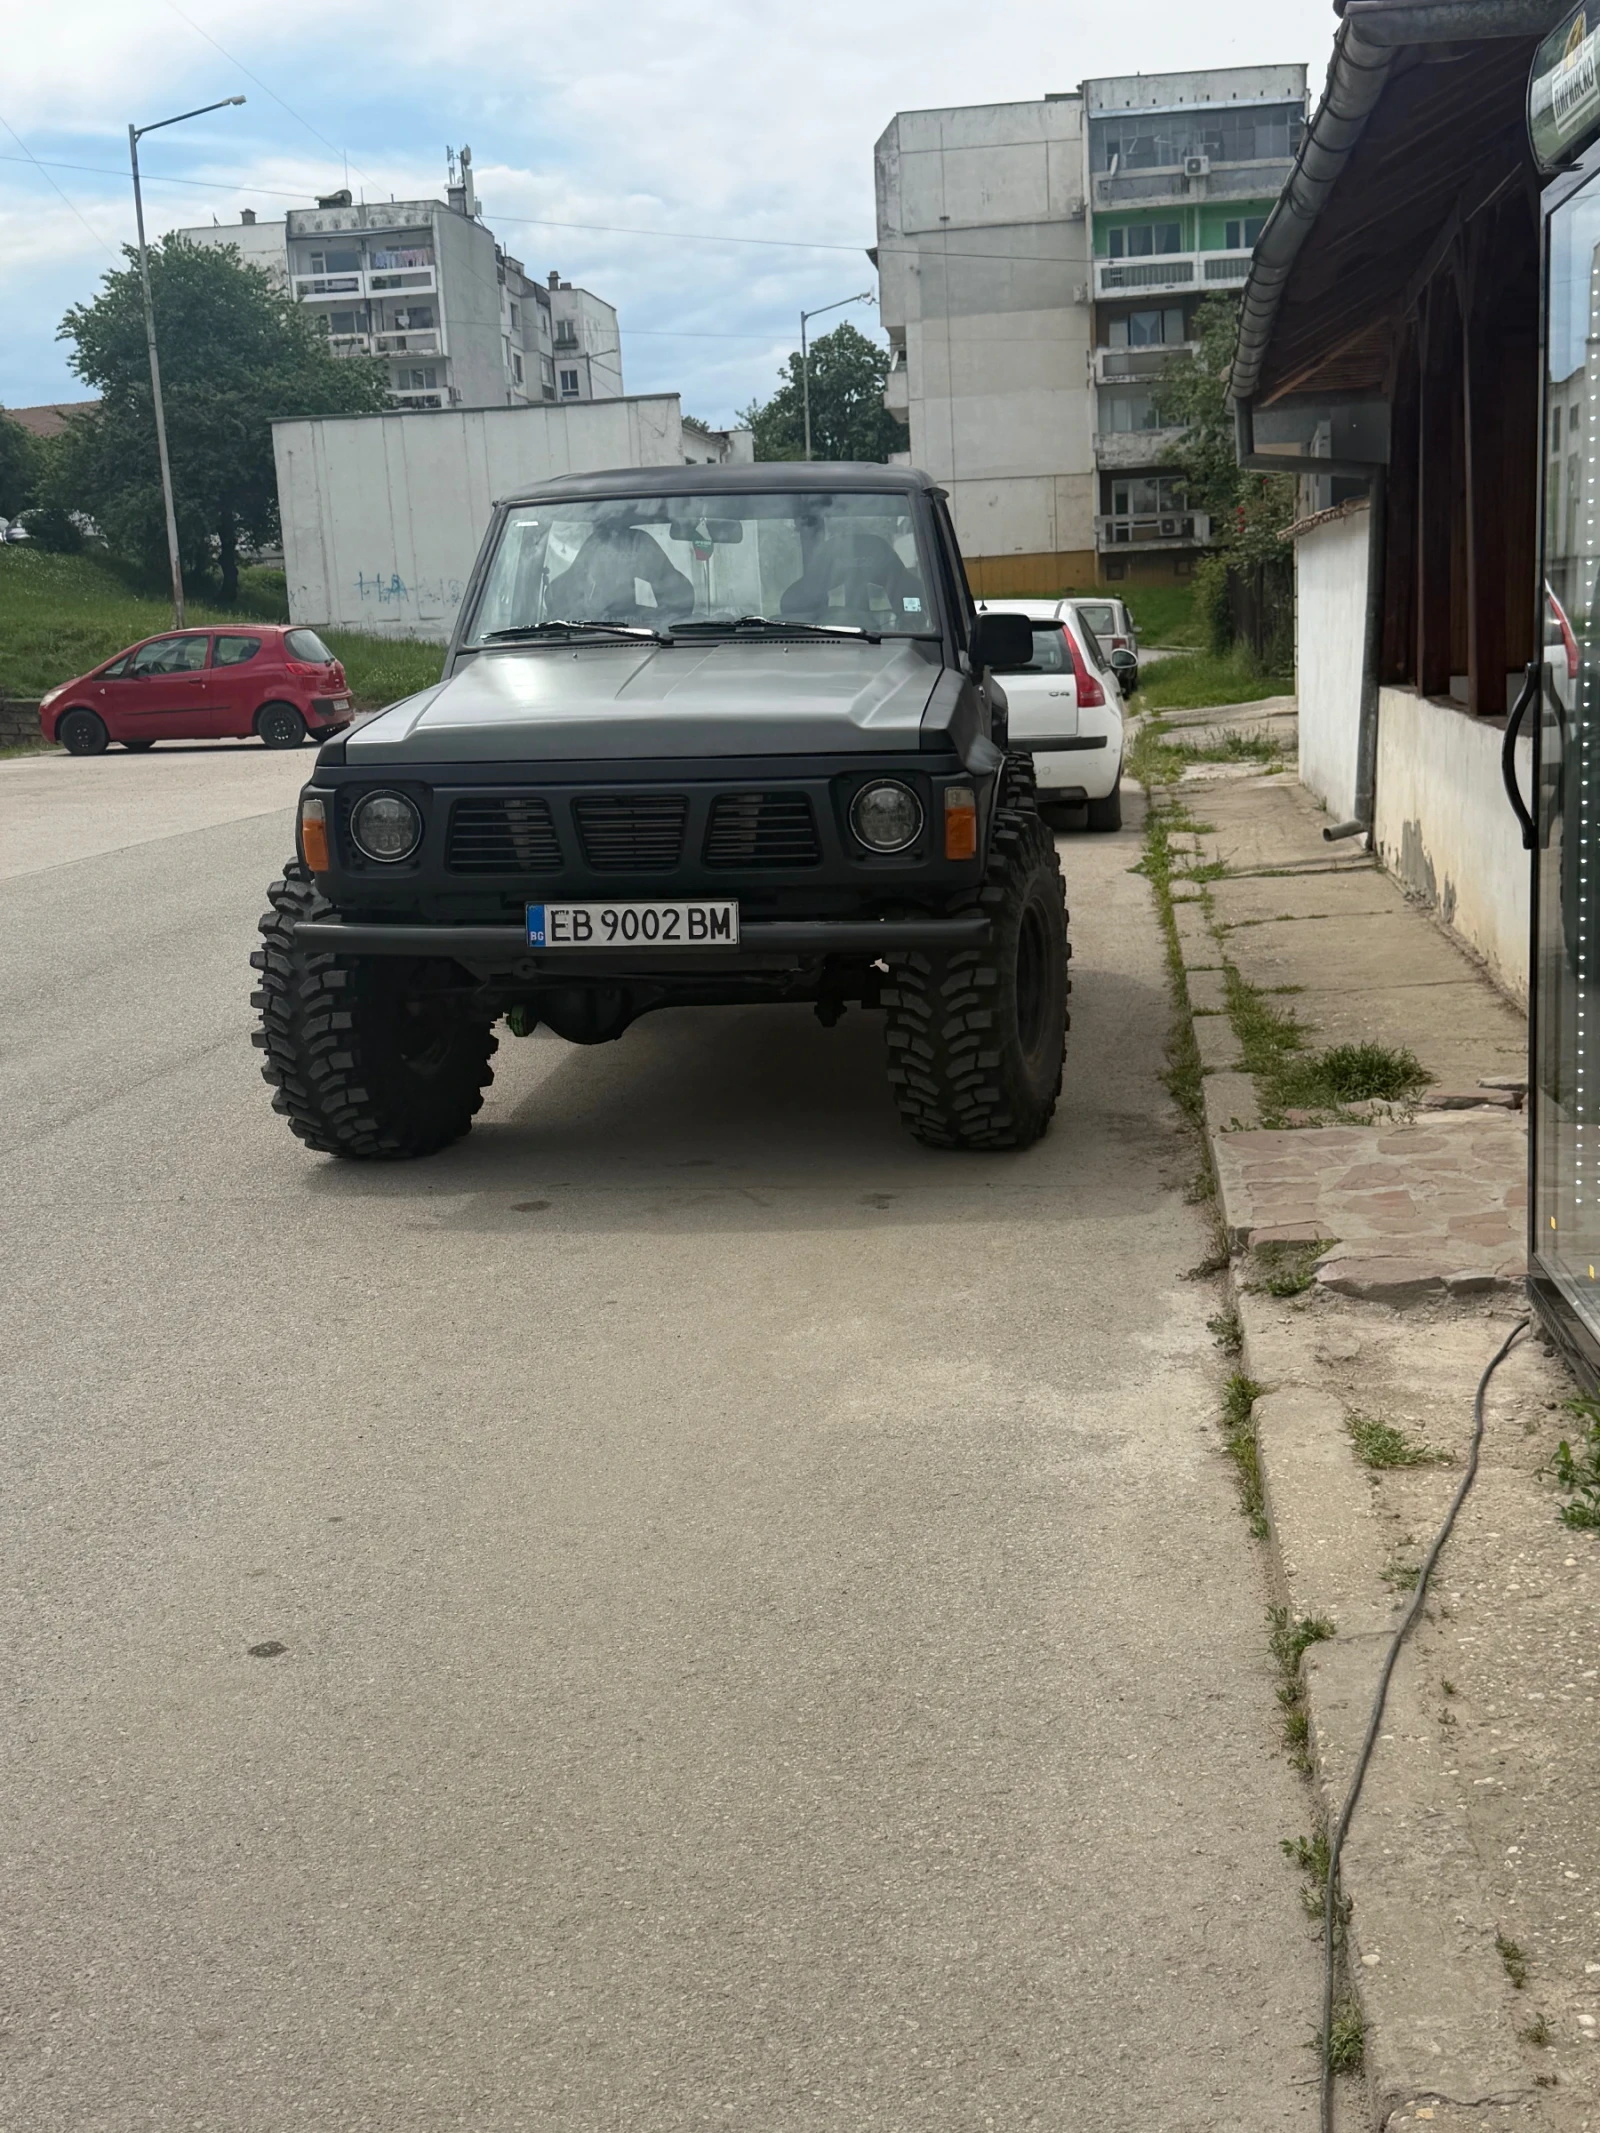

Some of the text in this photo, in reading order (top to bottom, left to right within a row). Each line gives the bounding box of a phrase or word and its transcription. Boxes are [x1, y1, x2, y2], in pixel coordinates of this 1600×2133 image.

[551, 907, 731, 941] EB 9002 BM
[530, 931, 544, 941] BG
